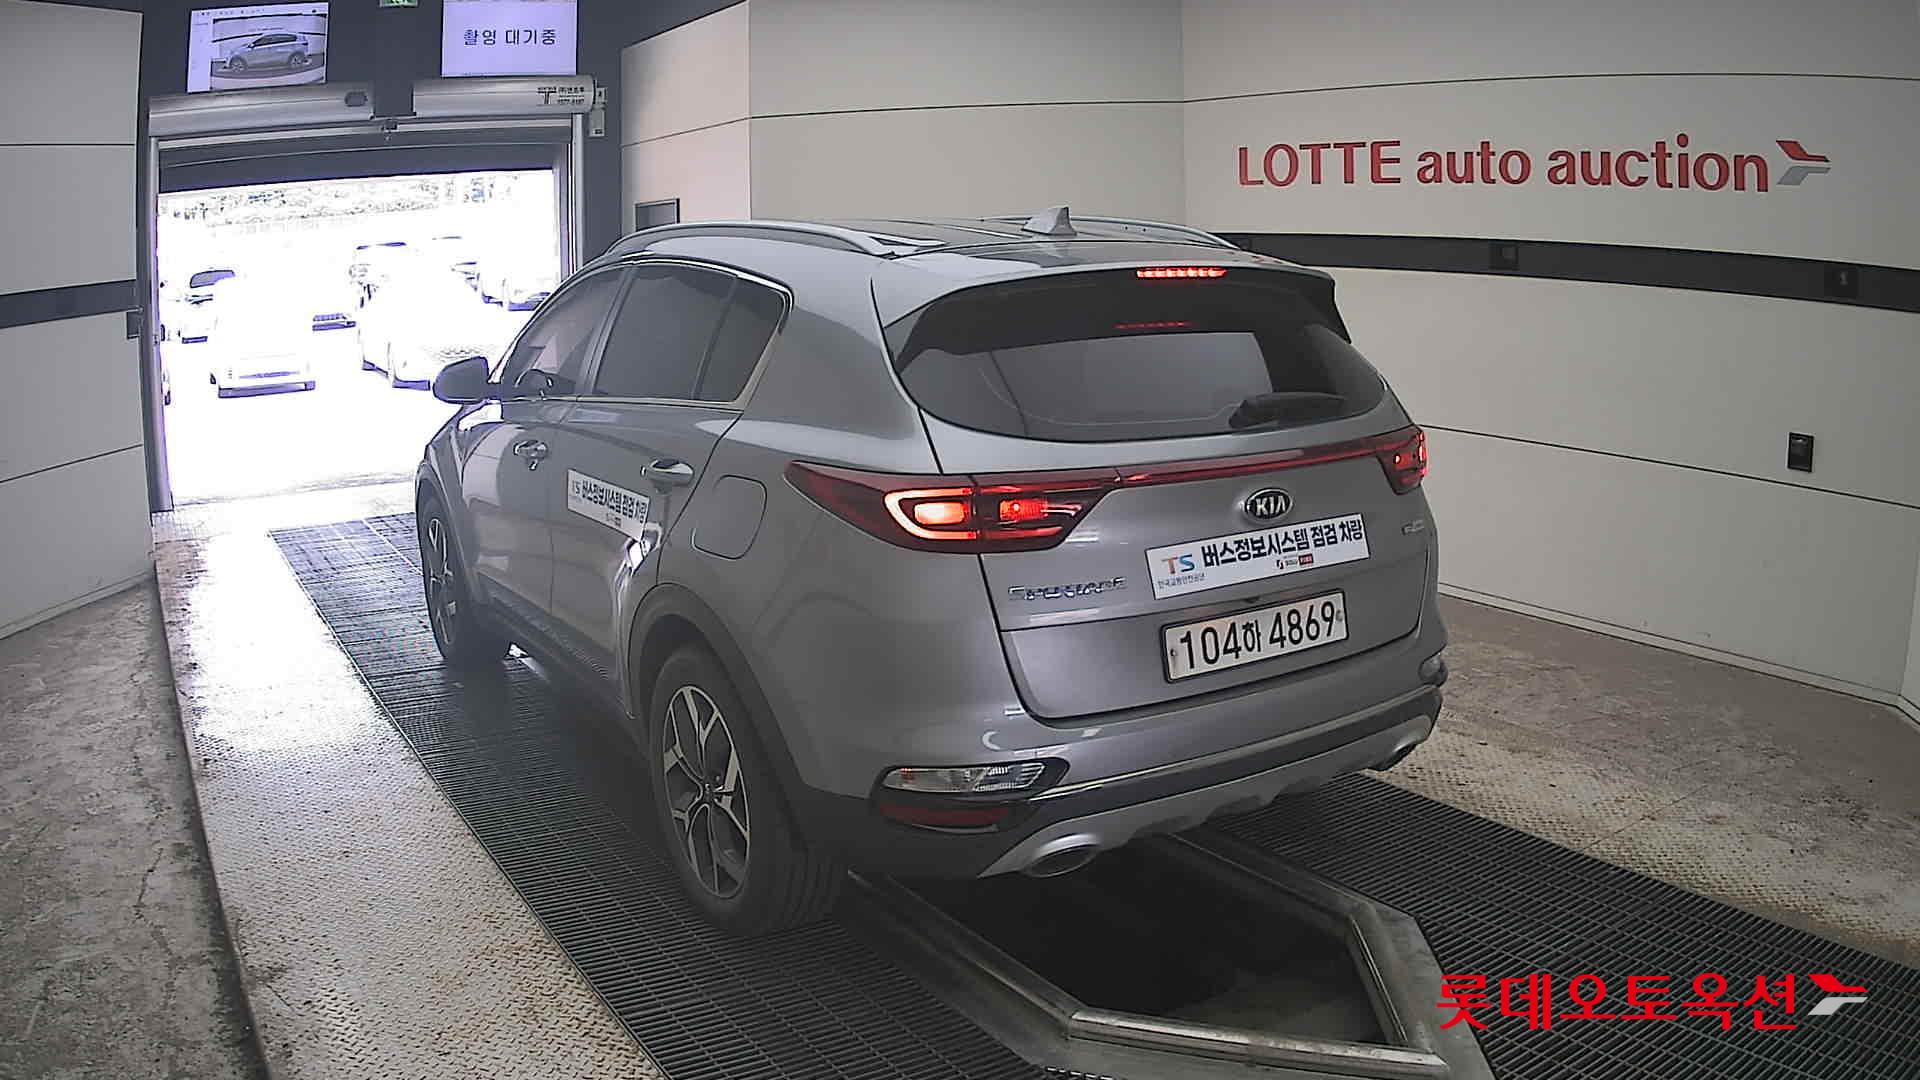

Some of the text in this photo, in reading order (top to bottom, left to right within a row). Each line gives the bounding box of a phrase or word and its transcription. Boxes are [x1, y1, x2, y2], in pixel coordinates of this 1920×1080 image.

[463, 29, 556, 46] 촬영 대기중
[1238, 132, 1770, 193] LOTTE auto auction
[582, 480, 622, 514] 버스정보시스템
[1255, 495, 1286, 516] KIA
[1201, 528, 1310, 568] 버스정보시스템
[1310, 523, 1338, 548] 점검
[1338, 519, 1364, 542] 차량
[1161, 553, 1196, 574] TS
[1180, 601, 1335, 669] 104하 4869
